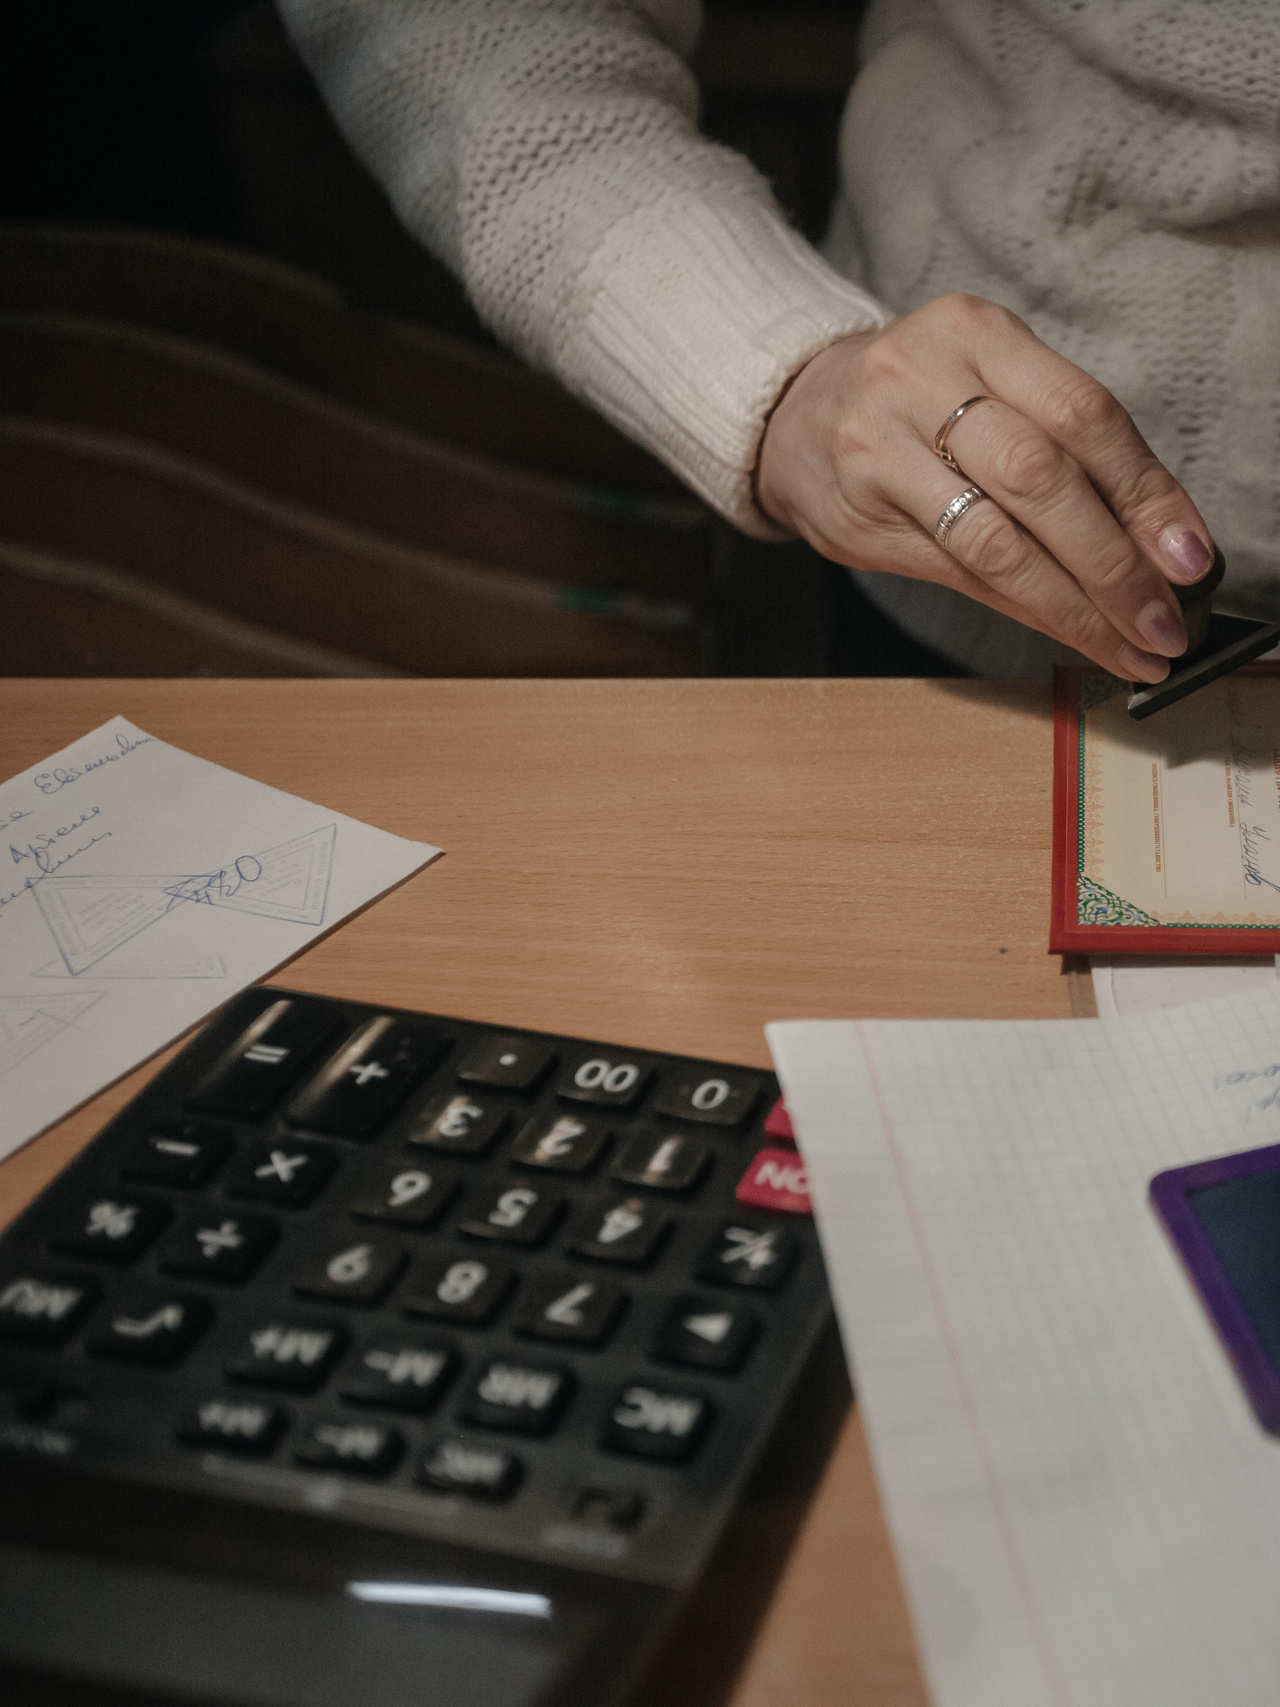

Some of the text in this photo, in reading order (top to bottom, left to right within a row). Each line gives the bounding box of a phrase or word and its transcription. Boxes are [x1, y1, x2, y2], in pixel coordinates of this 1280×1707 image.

[573, 1058, 641, 1093] 00
[690, 1078, 730, 1111] 0
[438, 1101, 484, 1138] 3
[538, 1116, 588, 1157] 2
[648, 1134, 688, 1176] 1
[387, 1170, 433, 1207] 6
[487, 1186, 538, 1228] 5
[594, 1198, 644, 1244] 4
[326, 1243, 375, 1284] 9
[436, 1260, 488, 1304] 8
[545, 1281, 597, 1326] 7
